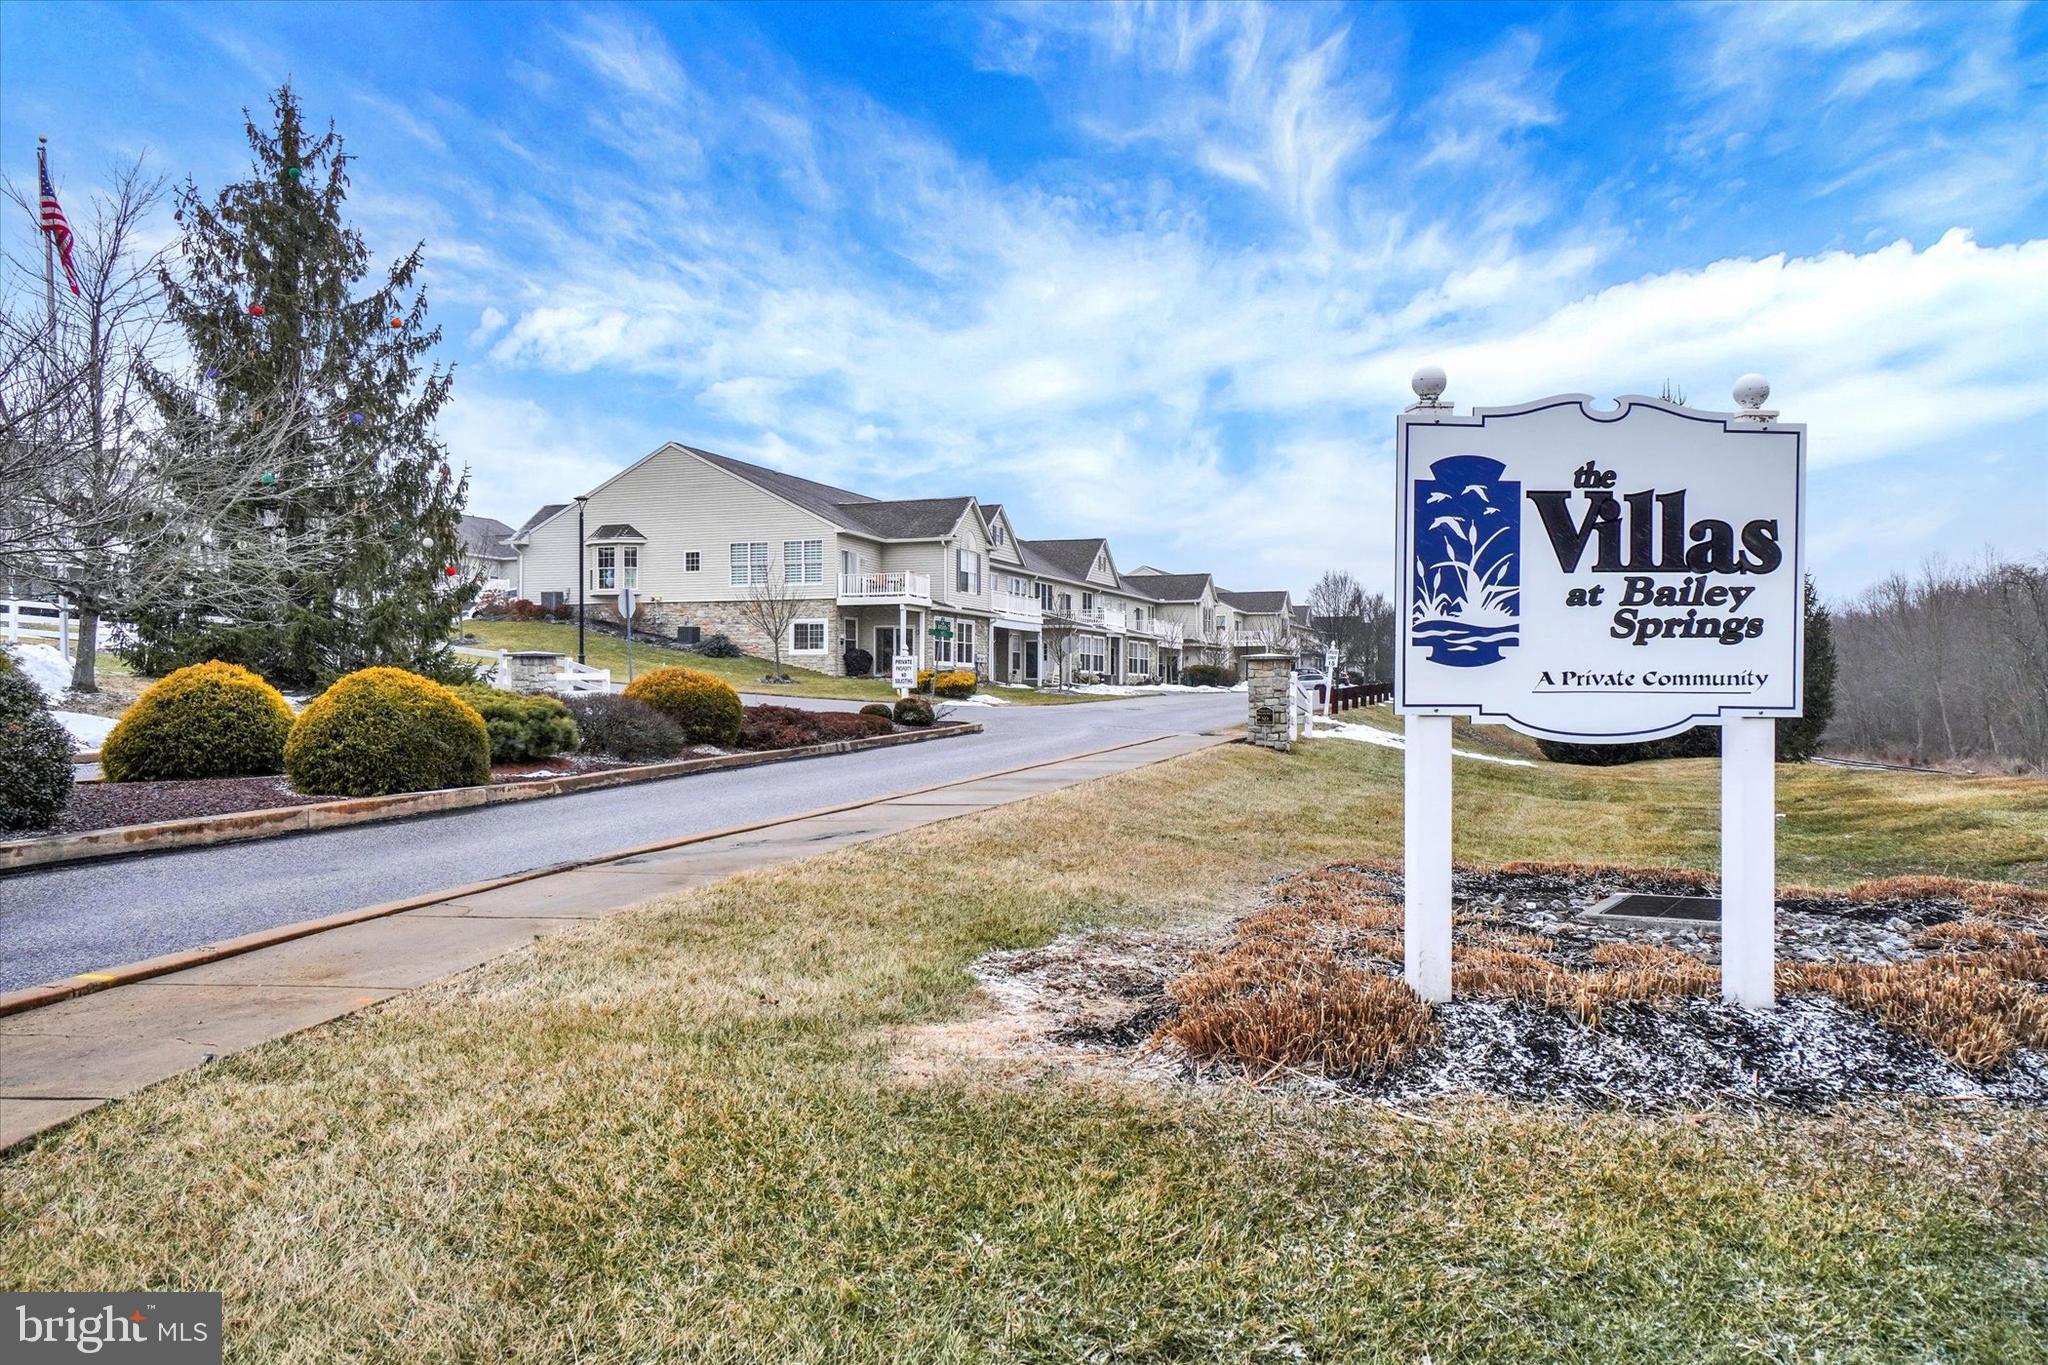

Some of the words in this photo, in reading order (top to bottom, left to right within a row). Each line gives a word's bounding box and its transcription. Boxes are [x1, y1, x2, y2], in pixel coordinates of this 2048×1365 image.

[1573, 460, 1617, 489] the
[1526, 488, 1783, 575] Villas
[1565, 584, 1605, 607] at
[1618, 575, 1756, 613] Bailey
[1610, 608, 1764, 646] Springs
[1532, 671, 1556, 691] A
[1561, 669, 1635, 687] Private
[1642, 669, 1769, 693] Community
